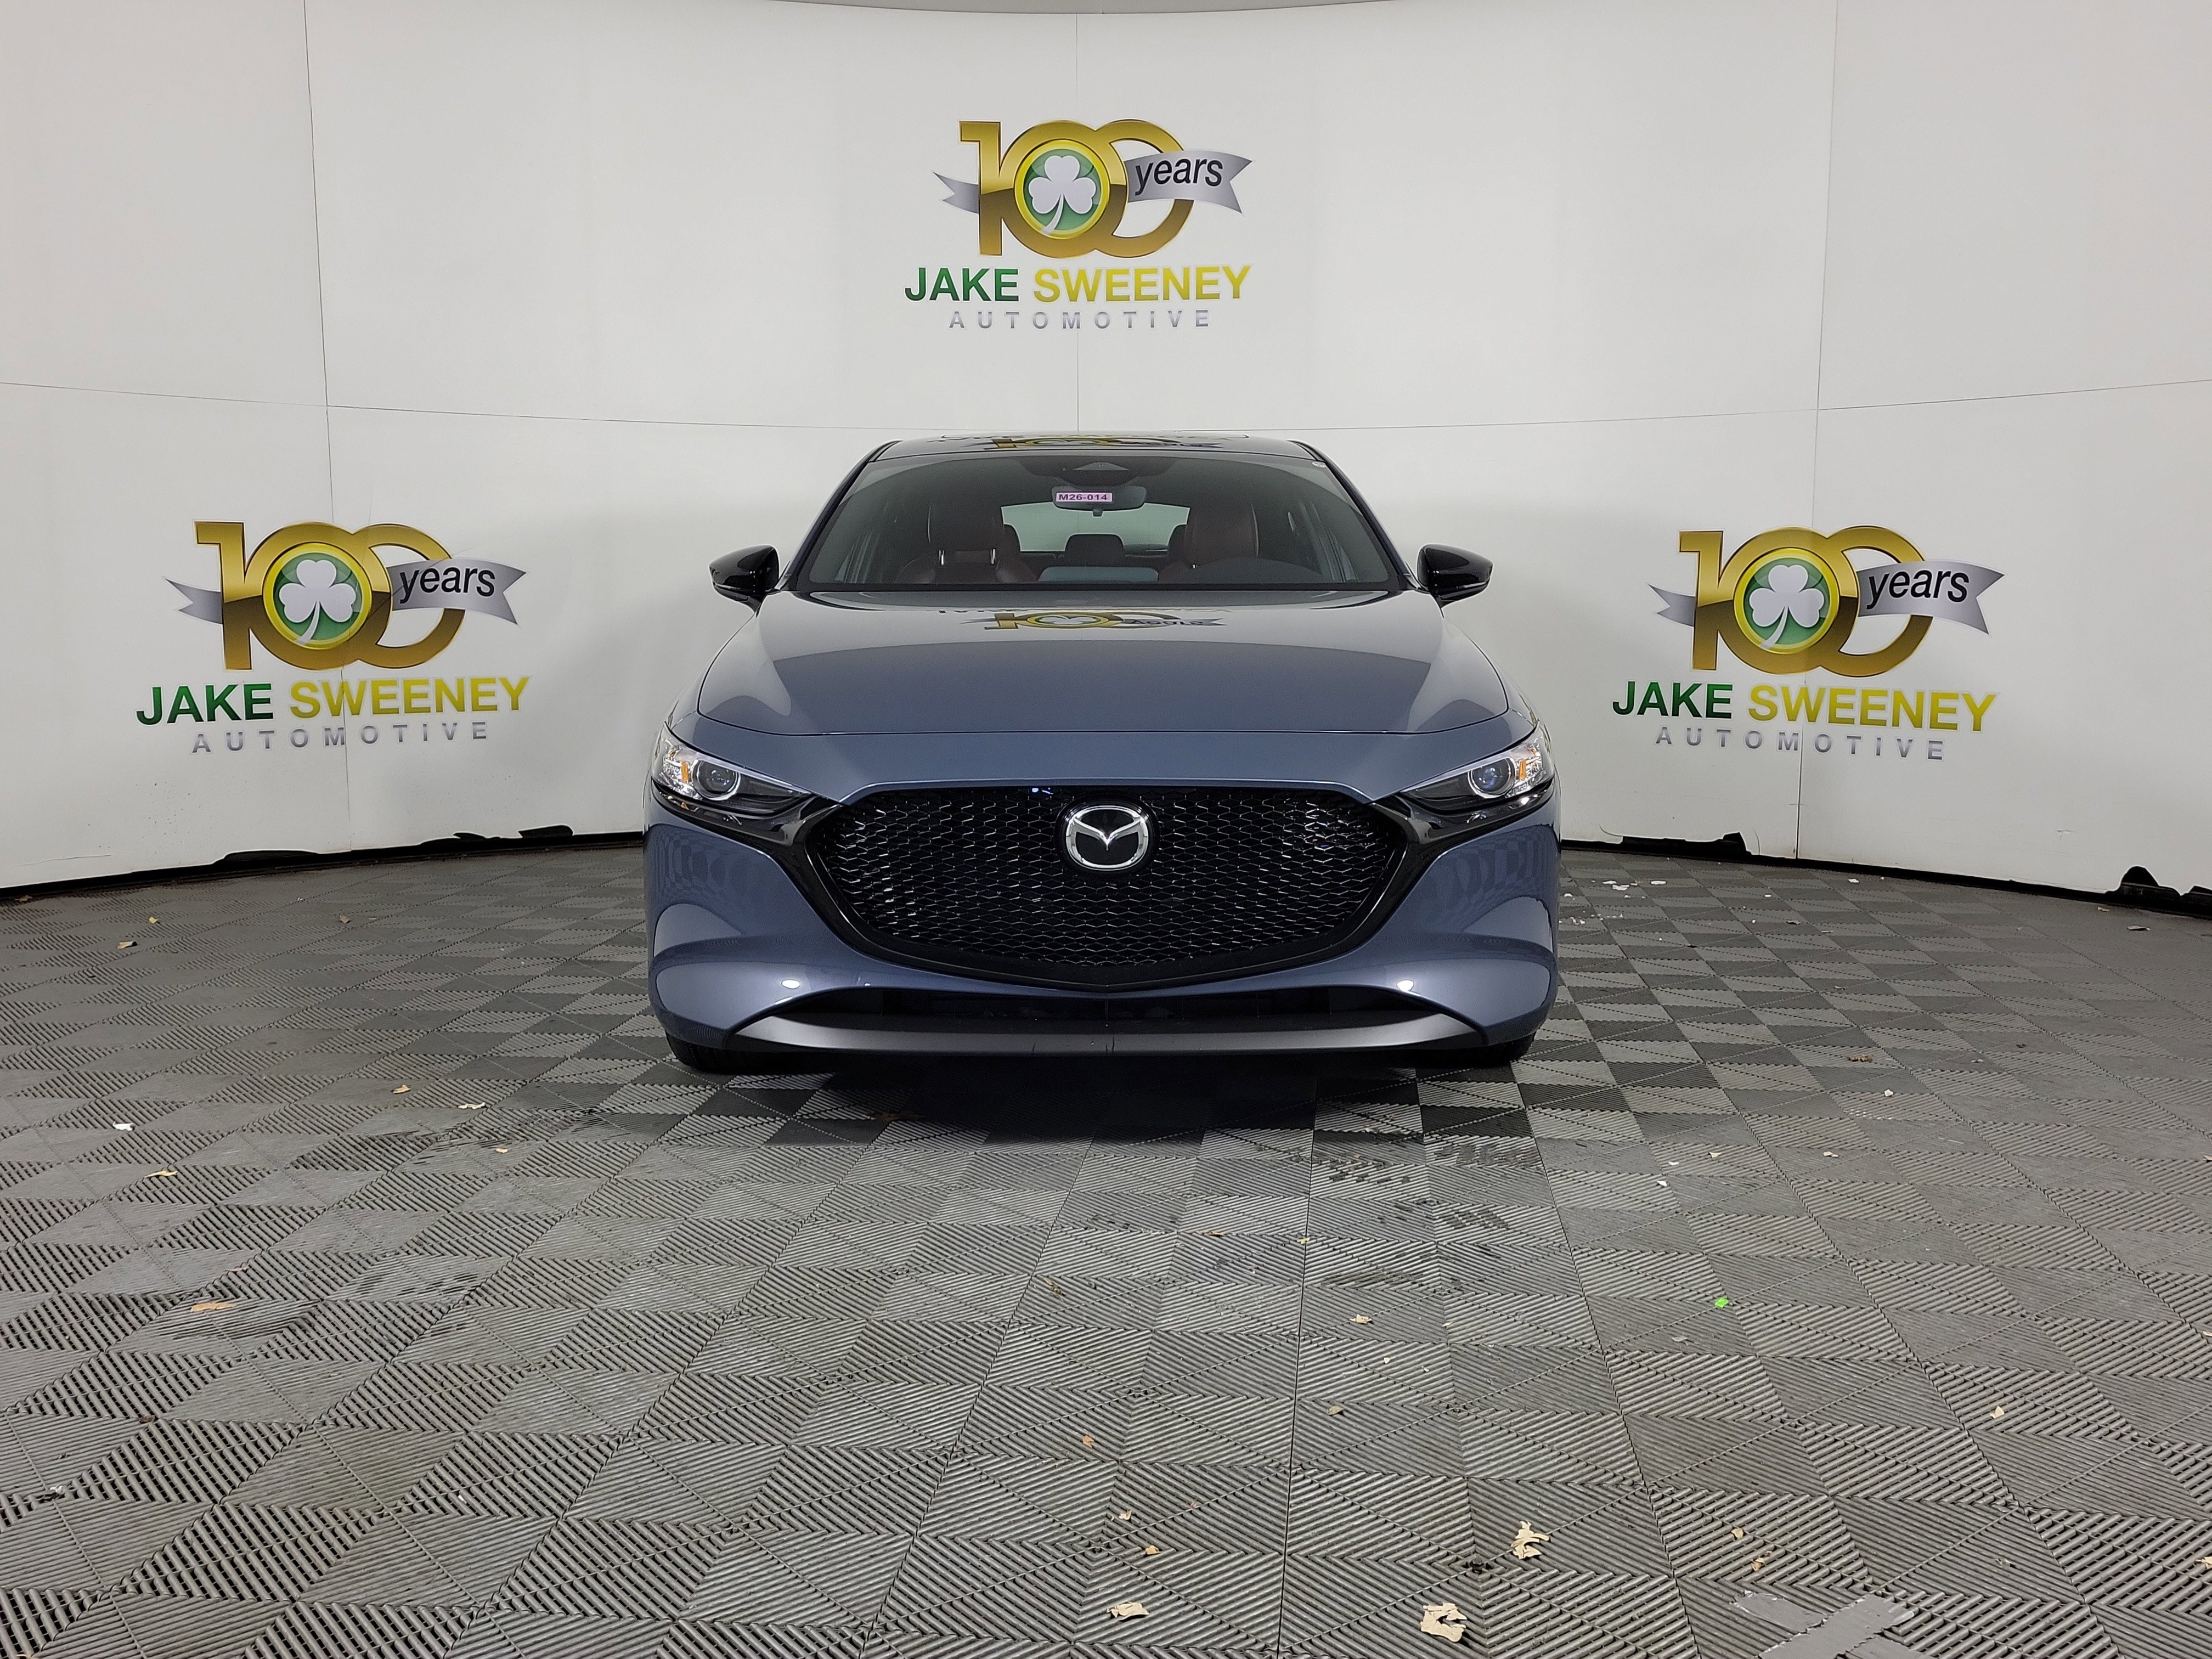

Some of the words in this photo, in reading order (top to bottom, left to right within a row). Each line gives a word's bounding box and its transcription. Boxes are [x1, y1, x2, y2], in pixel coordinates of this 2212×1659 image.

[958, 120, 1195, 258] 100
[1134, 157, 1223, 196] years
[905, 267, 1019, 301] JAKE
[1034, 266, 1251, 302] SWEENEY
[949, 309, 1209, 329] AUTOMOTIVE
[194, 521, 466, 672] 100
[399, 567, 495, 604] years
[1679, 525, 1934, 678] 100
[1866, 568, 1970, 610] years
[137, 683, 274, 725] JAKE
[290, 677, 531, 719] SWEENEY
[1612, 681, 1733, 719] JAKE
[1748, 685, 1996, 732] SWEENEY
[193, 722, 487, 754] AUTOMOTIVE
[1656, 726, 1944, 760] AUTOMOTIVE
